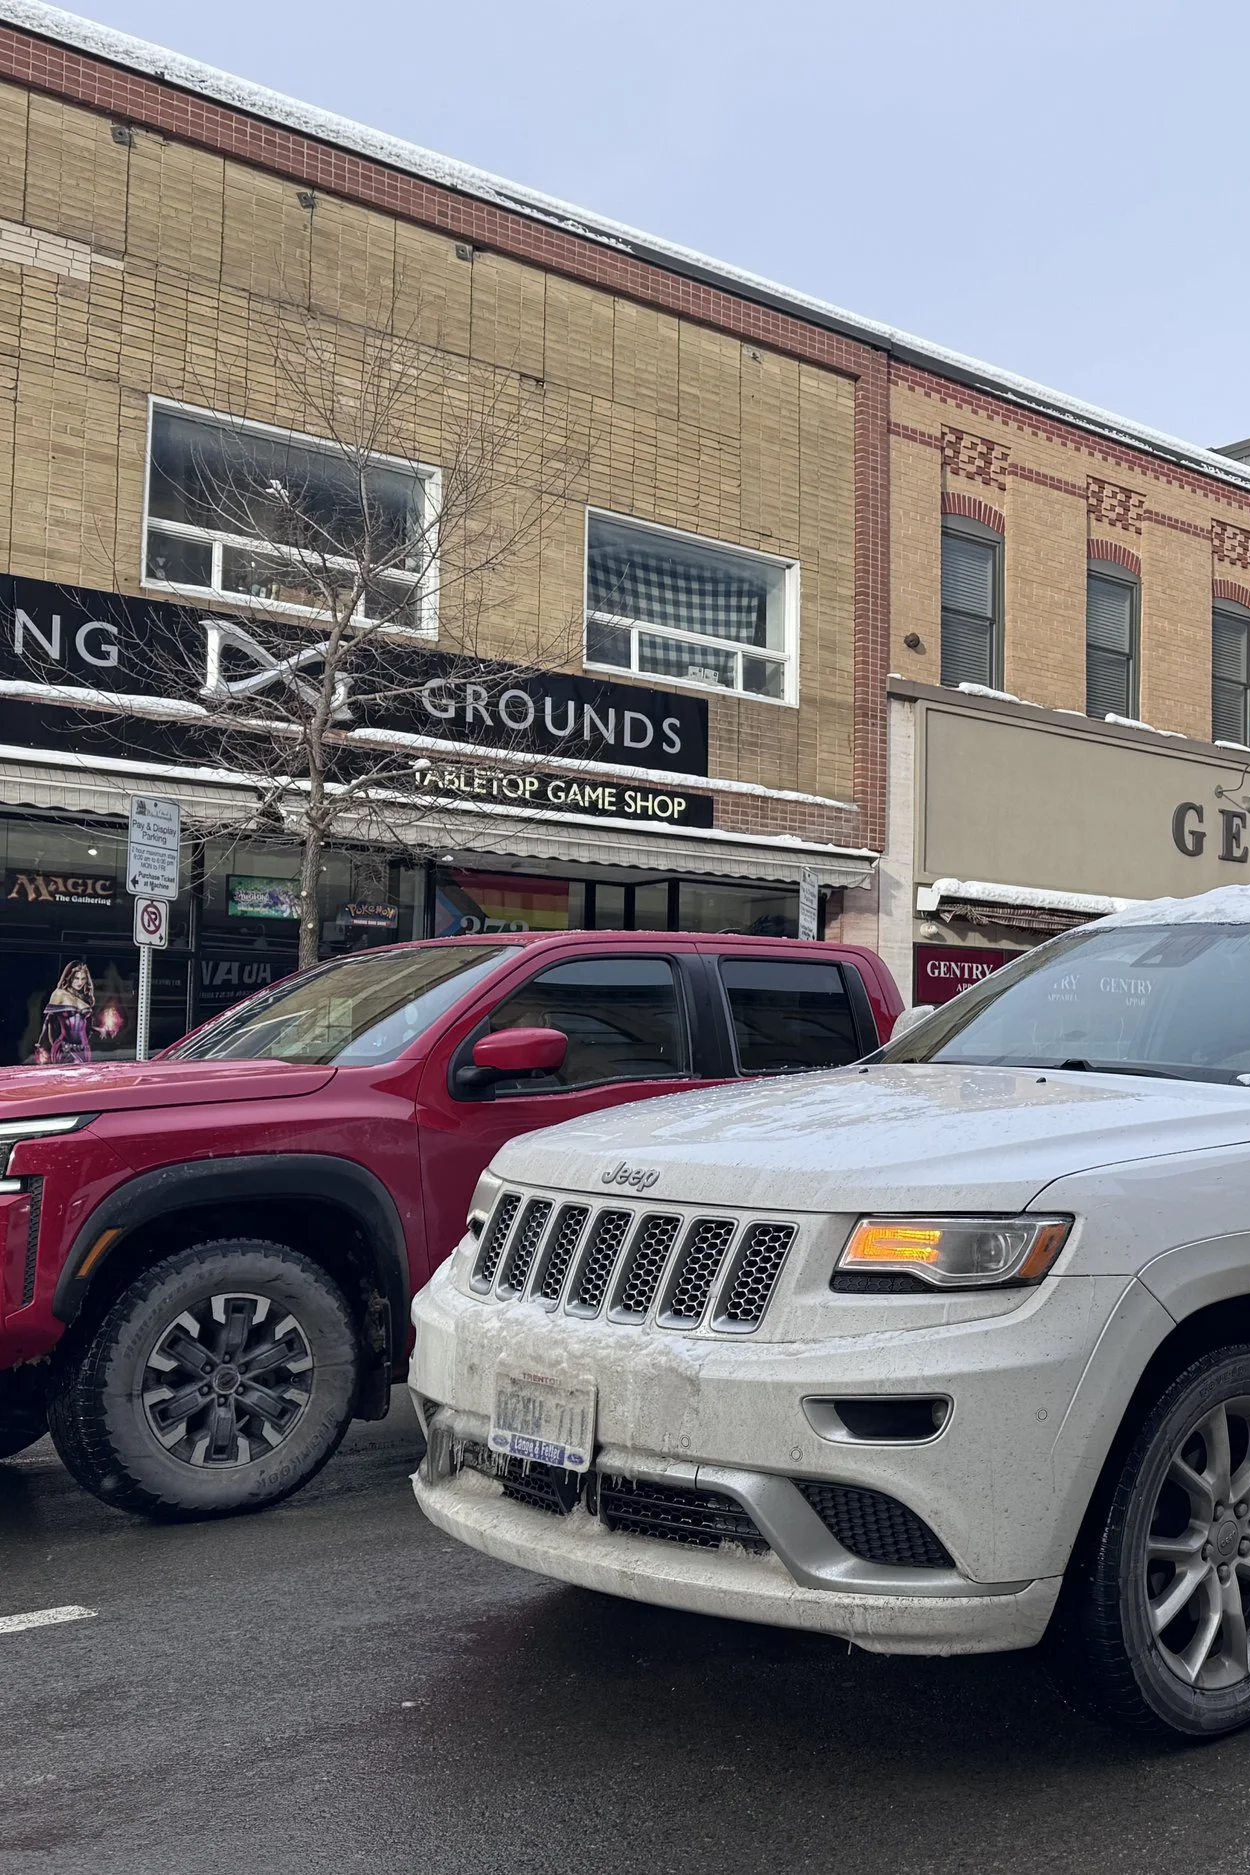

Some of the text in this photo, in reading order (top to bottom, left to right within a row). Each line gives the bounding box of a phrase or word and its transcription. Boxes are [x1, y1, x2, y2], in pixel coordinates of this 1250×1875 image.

[421, 677, 682, 755] GROUNDS
[413, 765, 687, 819] TABLETOP GAME SHOP
[132, 819, 177, 838] Pay & Display
[142, 831, 167, 845] Parking
[138, 870, 176, 884] Purchase Ticket
[149, 880, 170, 890] Machine
[55, 894, 111, 906] The Gathering
[926, 960, 994, 980] GENTRY
[1100, 976, 1152, 995] GENTRY
[600, 1160, 660, 1192] Jeep
